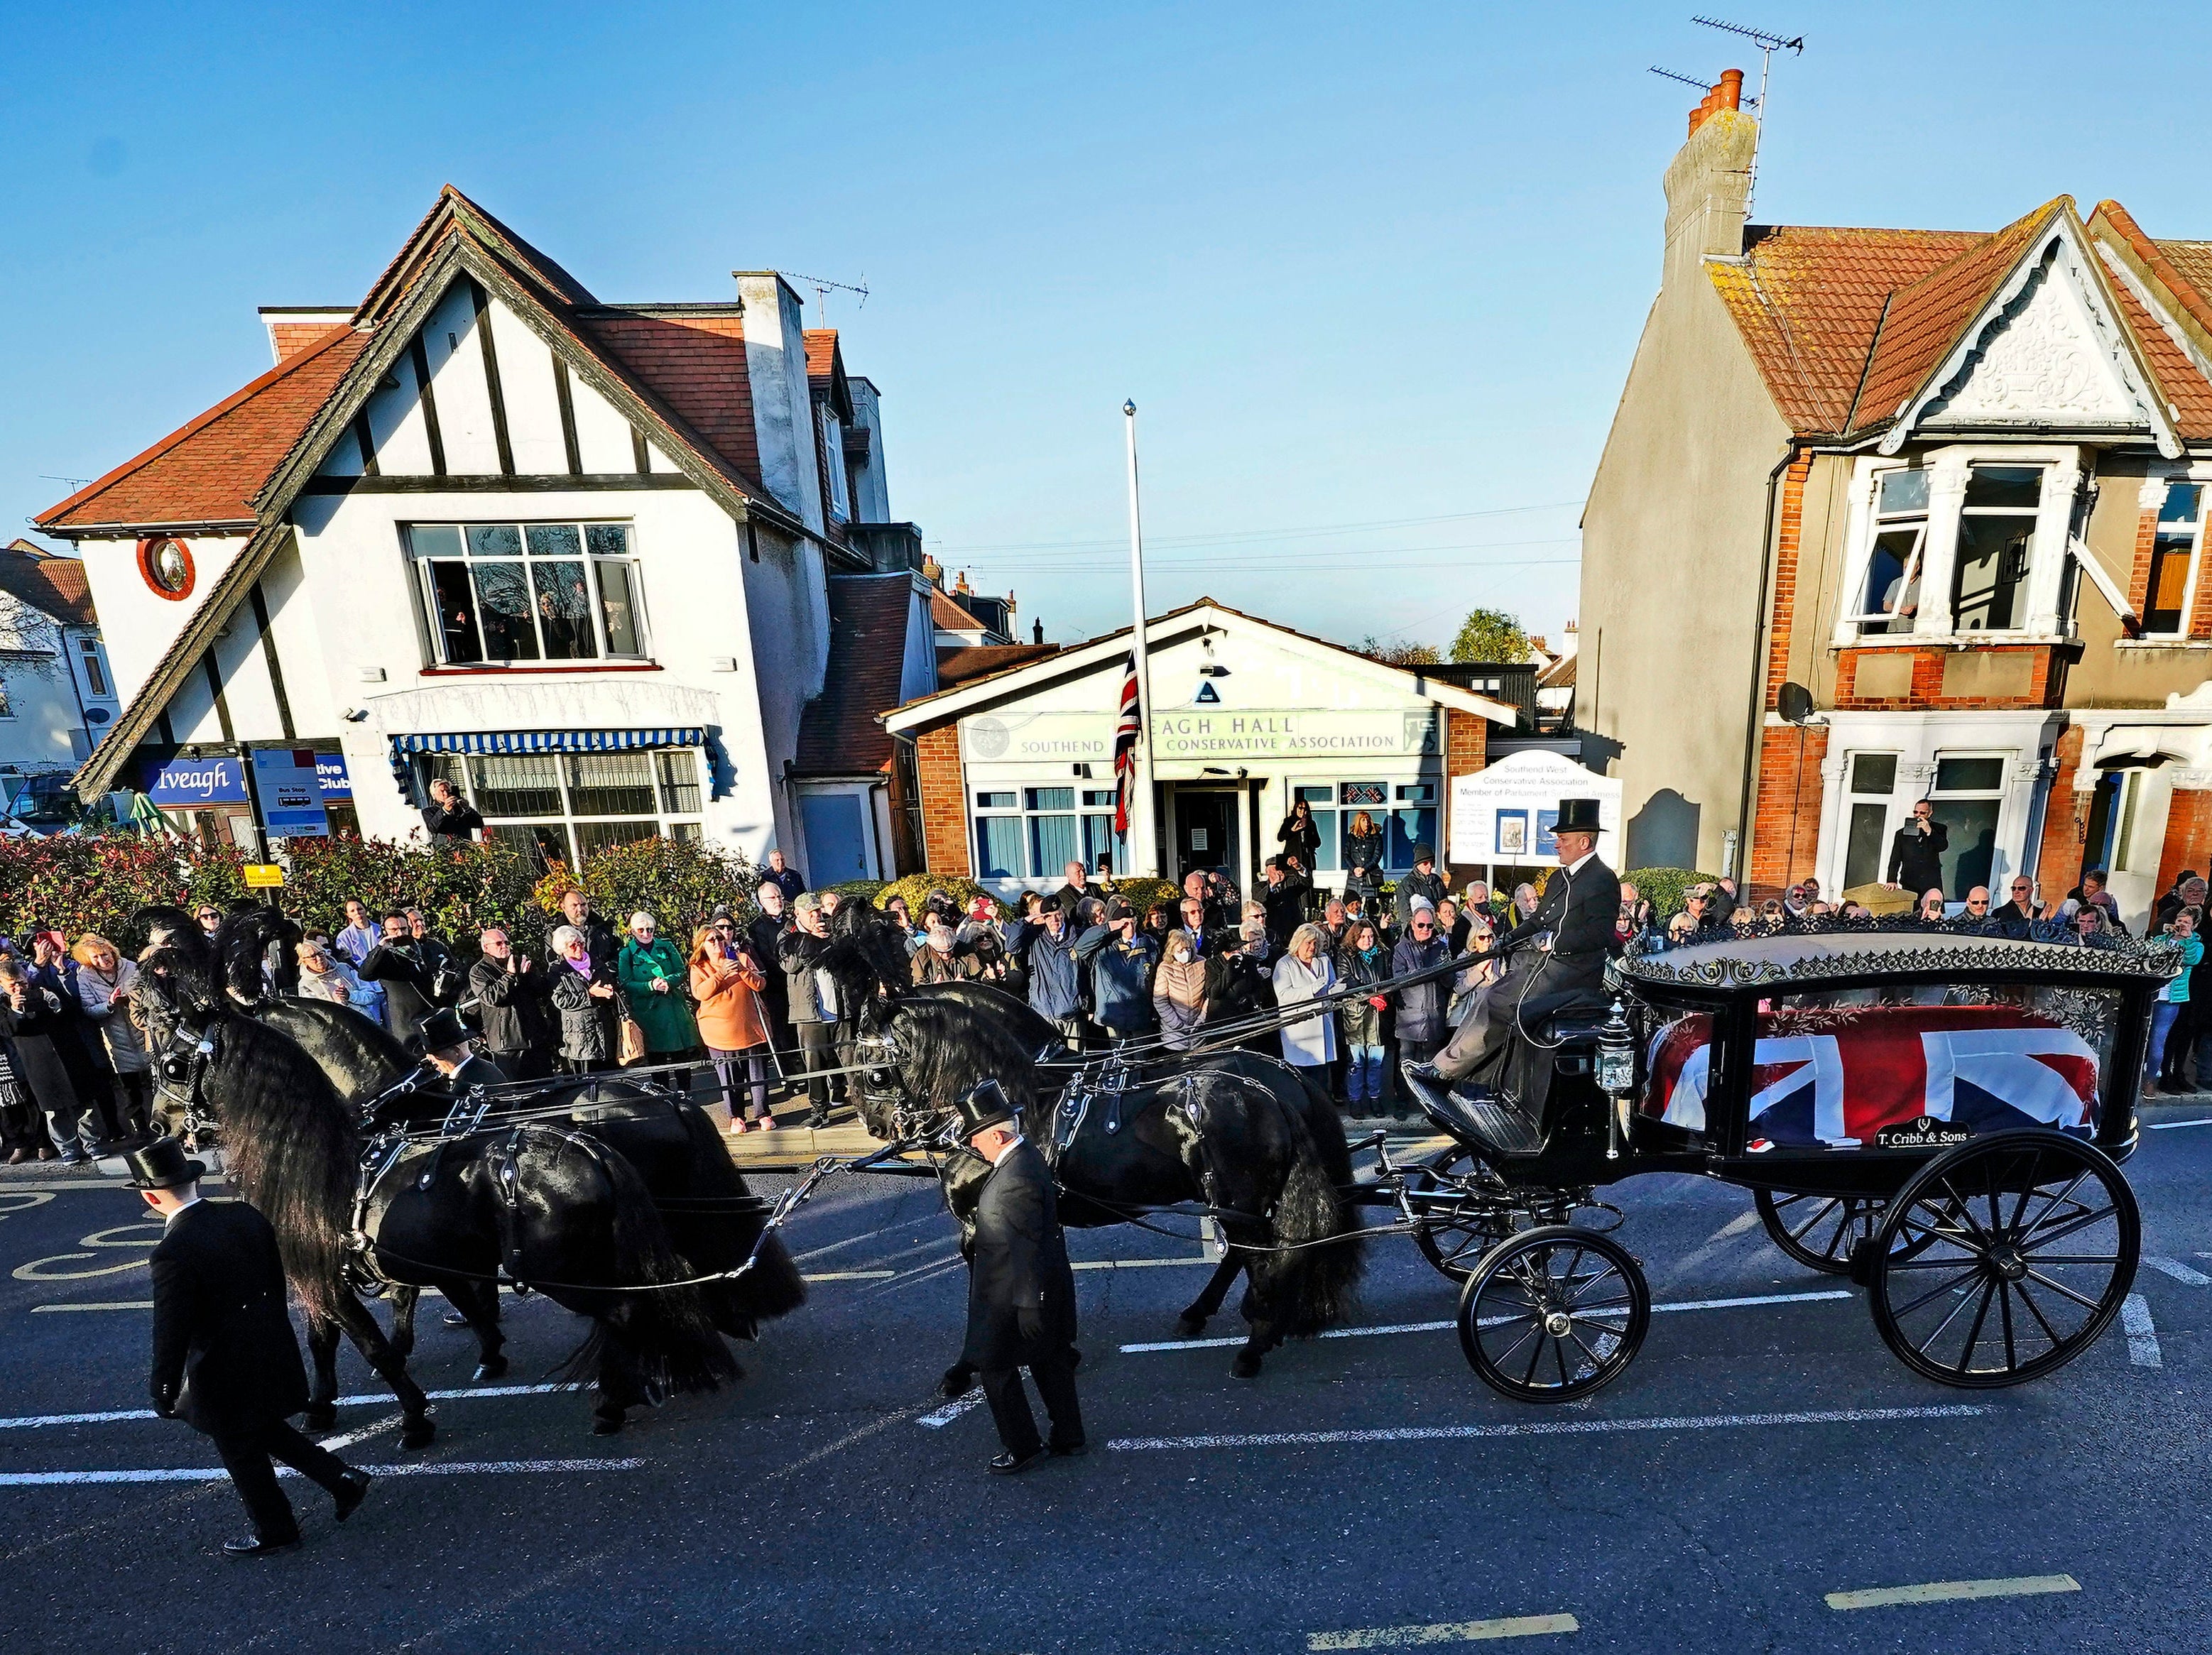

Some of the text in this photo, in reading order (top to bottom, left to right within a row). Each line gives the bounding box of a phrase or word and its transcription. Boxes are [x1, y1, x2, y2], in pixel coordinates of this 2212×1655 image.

[1233, 717, 1293, 733] HALL
[1021, 736, 1394, 753] SOUTHEND CONSERVATIVE ASSOCIATION
[158, 762, 230, 797] Iveagh
[318, 777, 350, 789] Club
[1878, 1131, 1967, 1145] T. Cribb & Sons
